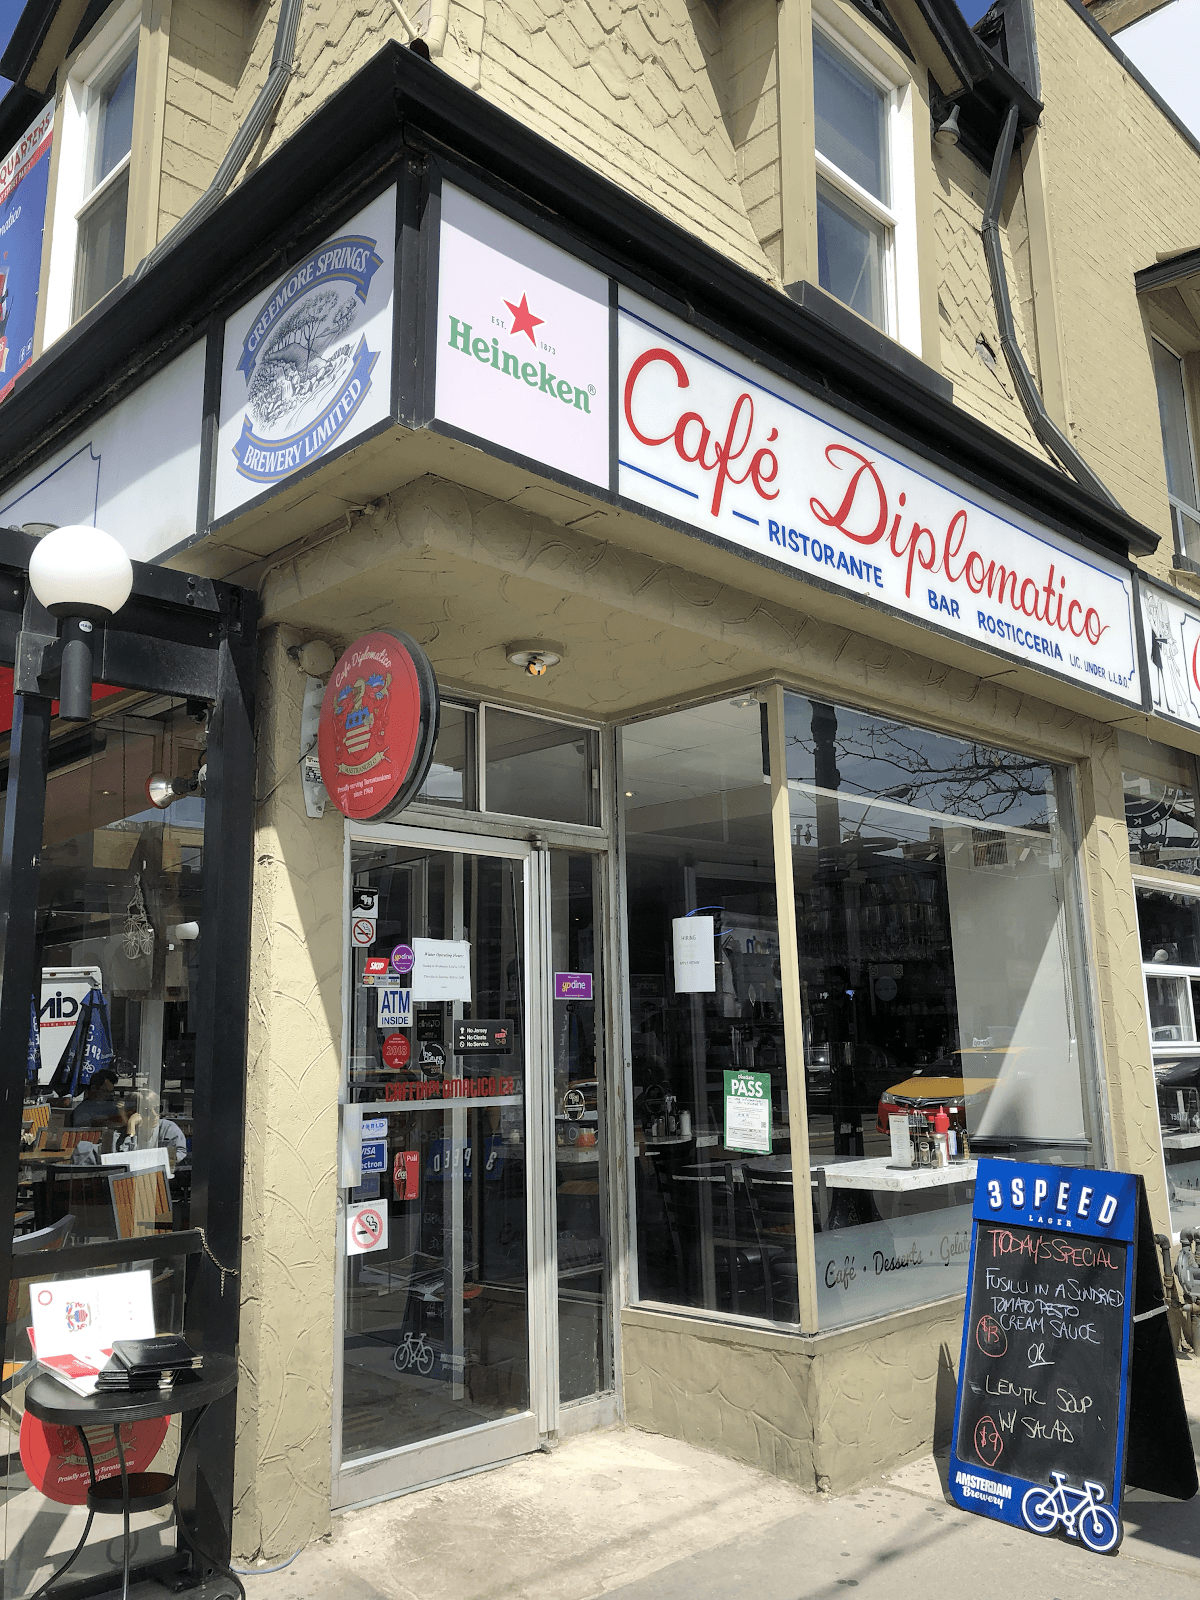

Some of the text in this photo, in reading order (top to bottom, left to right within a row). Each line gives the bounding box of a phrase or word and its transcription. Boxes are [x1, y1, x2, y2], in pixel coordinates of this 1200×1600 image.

[247, 246, 370, 352] CREEMORE SPRINGS
[491, 315, 556, 355] EST. 1873
[242, 378, 361, 472] BREWERY LIMITED
[624, 348, 1111, 645] Café Diplomatico
[768, 518, 884, 588] RISTORANTE
[927, 589, 960, 619] BAR
[977, 610, 1063, 662] ROSTICCERIA
[1083, 660, 1106, 679] UNDER
[369, 961, 385, 970] SKIP
[380, 990, 410, 1014] ATM
[381, 1016, 409, 1025] INSIDE
[731, 1079, 763, 1097] PASS
[1028, 1214, 1072, 1227] LAGER
[825, 1256, 857, 1290] Café
[872, 1241, 924, 1275] Desserts
[1051, 1238, 1119, 1270] SPECIAL
[1034, 1283, 1049, 1295] IN
[1054, 1283, 1066, 1299] A
[991, 1296, 1035, 1314] TOMATO
[1000, 1313, 1044, 1334] CREAM
[1049, 1319, 1101, 1344] SAUCE
[1027, 1342, 1047, 1364] OR
[1056, 1388, 1093, 1413] SOUP
[979, 1425, 999, 1451] $9
[1020, 1416, 1075, 1443] SALAD
[57, 1472, 80, 1484] Proudly
[955, 1471, 1012, 1499] AMSTERDAM
[962, 1485, 1004, 1510] Brewery
